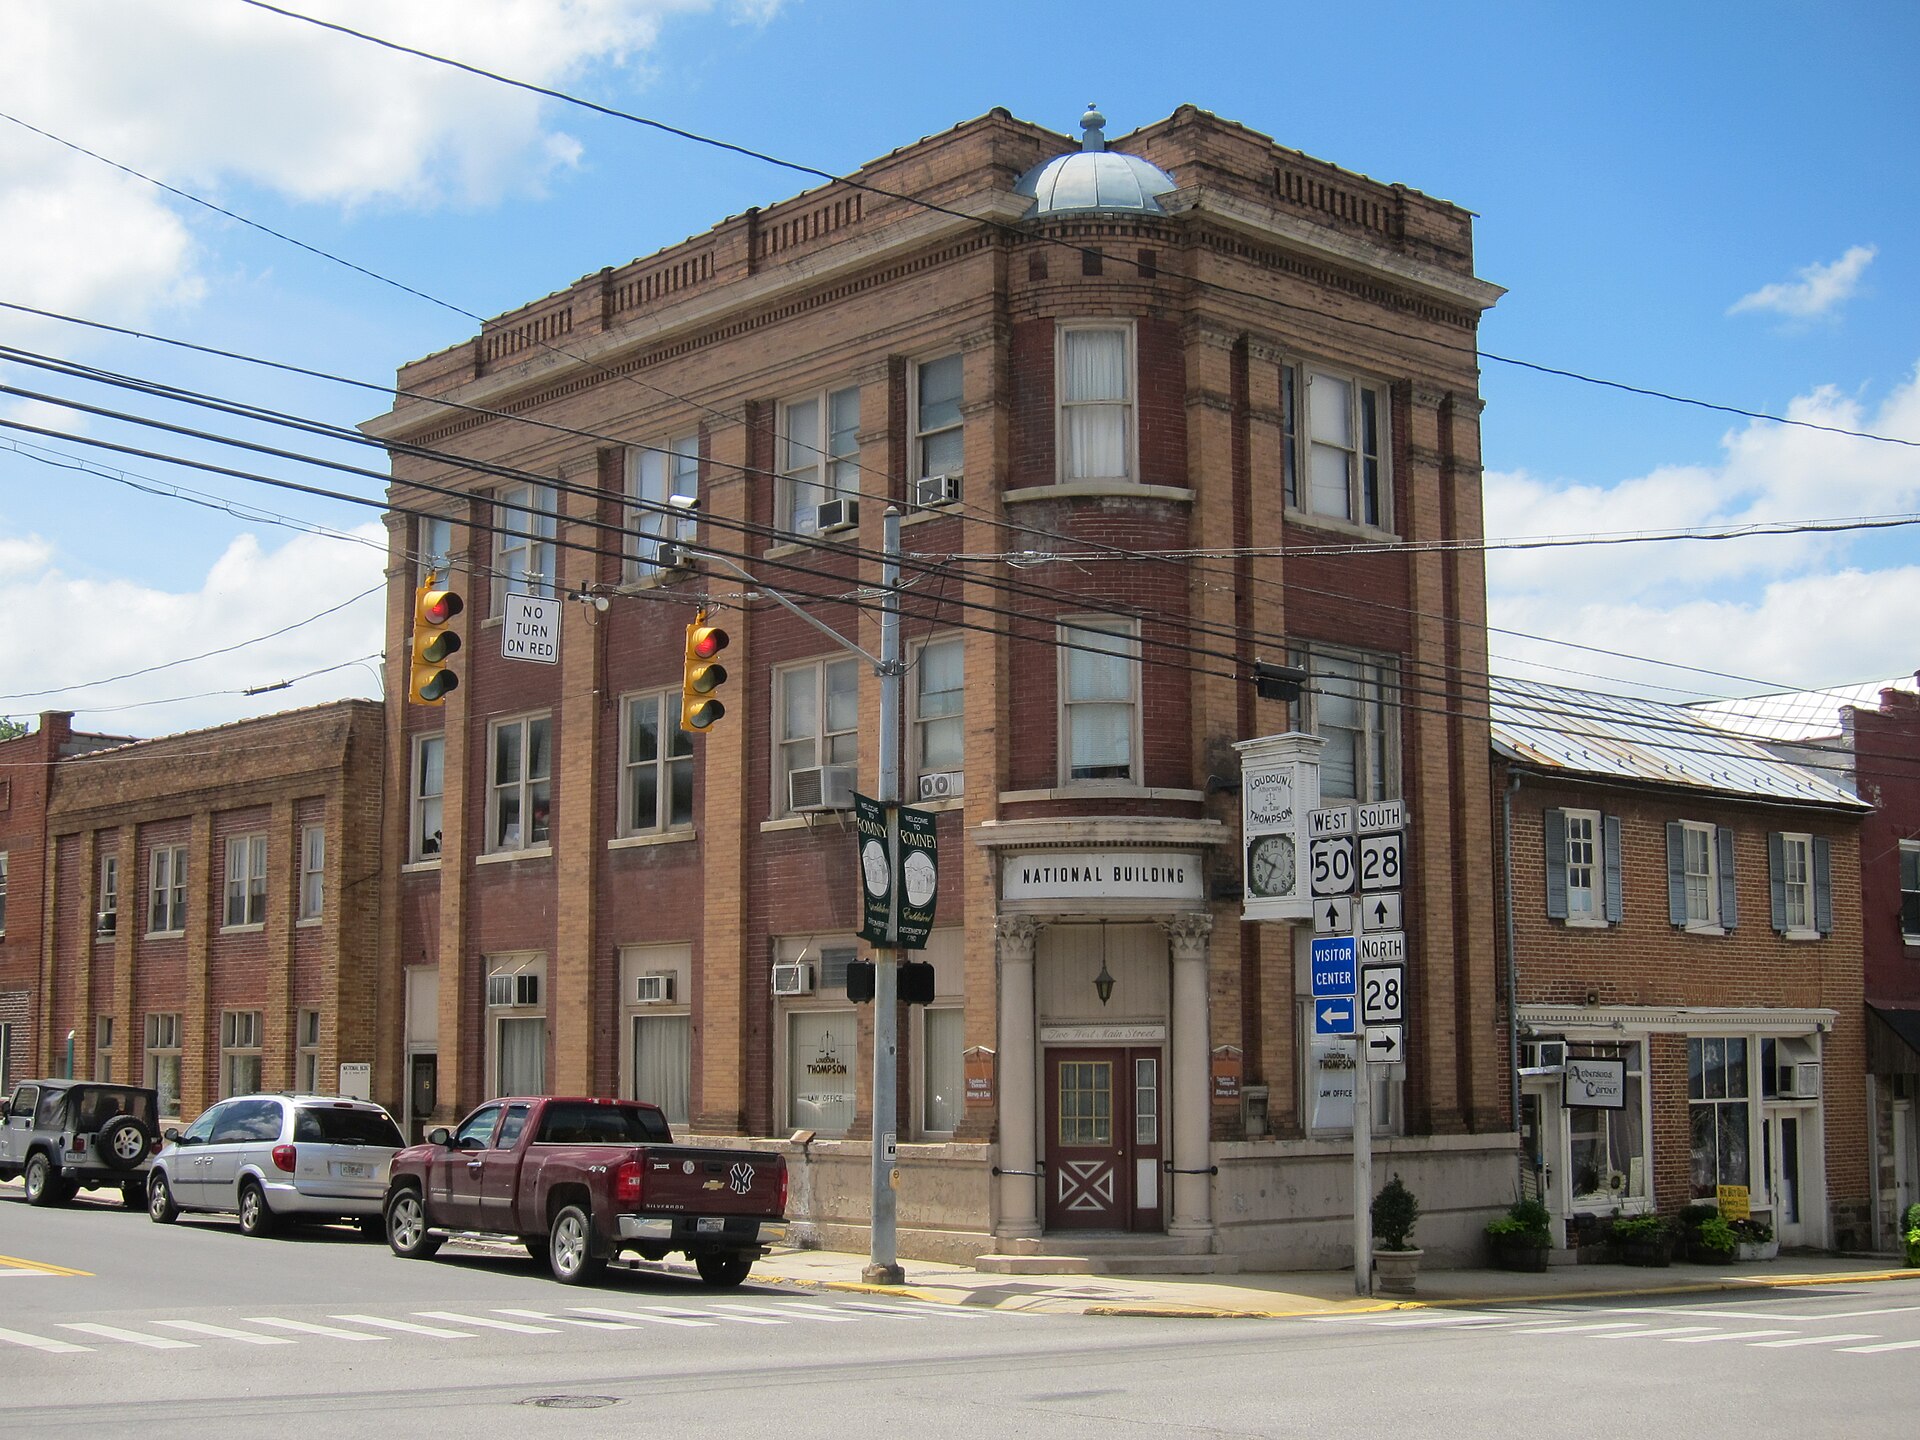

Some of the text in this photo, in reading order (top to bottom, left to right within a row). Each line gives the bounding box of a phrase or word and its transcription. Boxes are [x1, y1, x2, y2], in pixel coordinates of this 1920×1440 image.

[523, 605, 543, 619] NO
[516, 622, 548, 638] TURN
[507, 639, 553, 656] ON RED
[1250, 774, 1288, 790] LOUDOUN
[867, 811, 875, 820] TO
[904, 815, 928, 825] WELCOME
[1250, 806, 1293, 824] THOMPSON
[1314, 813, 1347, 832] WEST
[1360, 808, 1400, 828] SOUTH
[913, 823, 921, 831] TO
[900, 829, 937, 849] ROMNEY
[1315, 849, 1349, 882] 50
[1363, 846, 1398, 880] 28
[1023, 866, 1184, 884] NATIONAL BUILDING
[1315, 948, 1351, 962] VISITOR
[1362, 940, 1401, 958] NORTH
[1316, 972, 1351, 985] CENTER
[1366, 978, 1399, 1011] 28
[806, 1064, 847, 1075] THOMPSON
[1318, 1059, 1357, 1070] THOMPSON
[807, 1094, 843, 1103] LAW OFFICE
